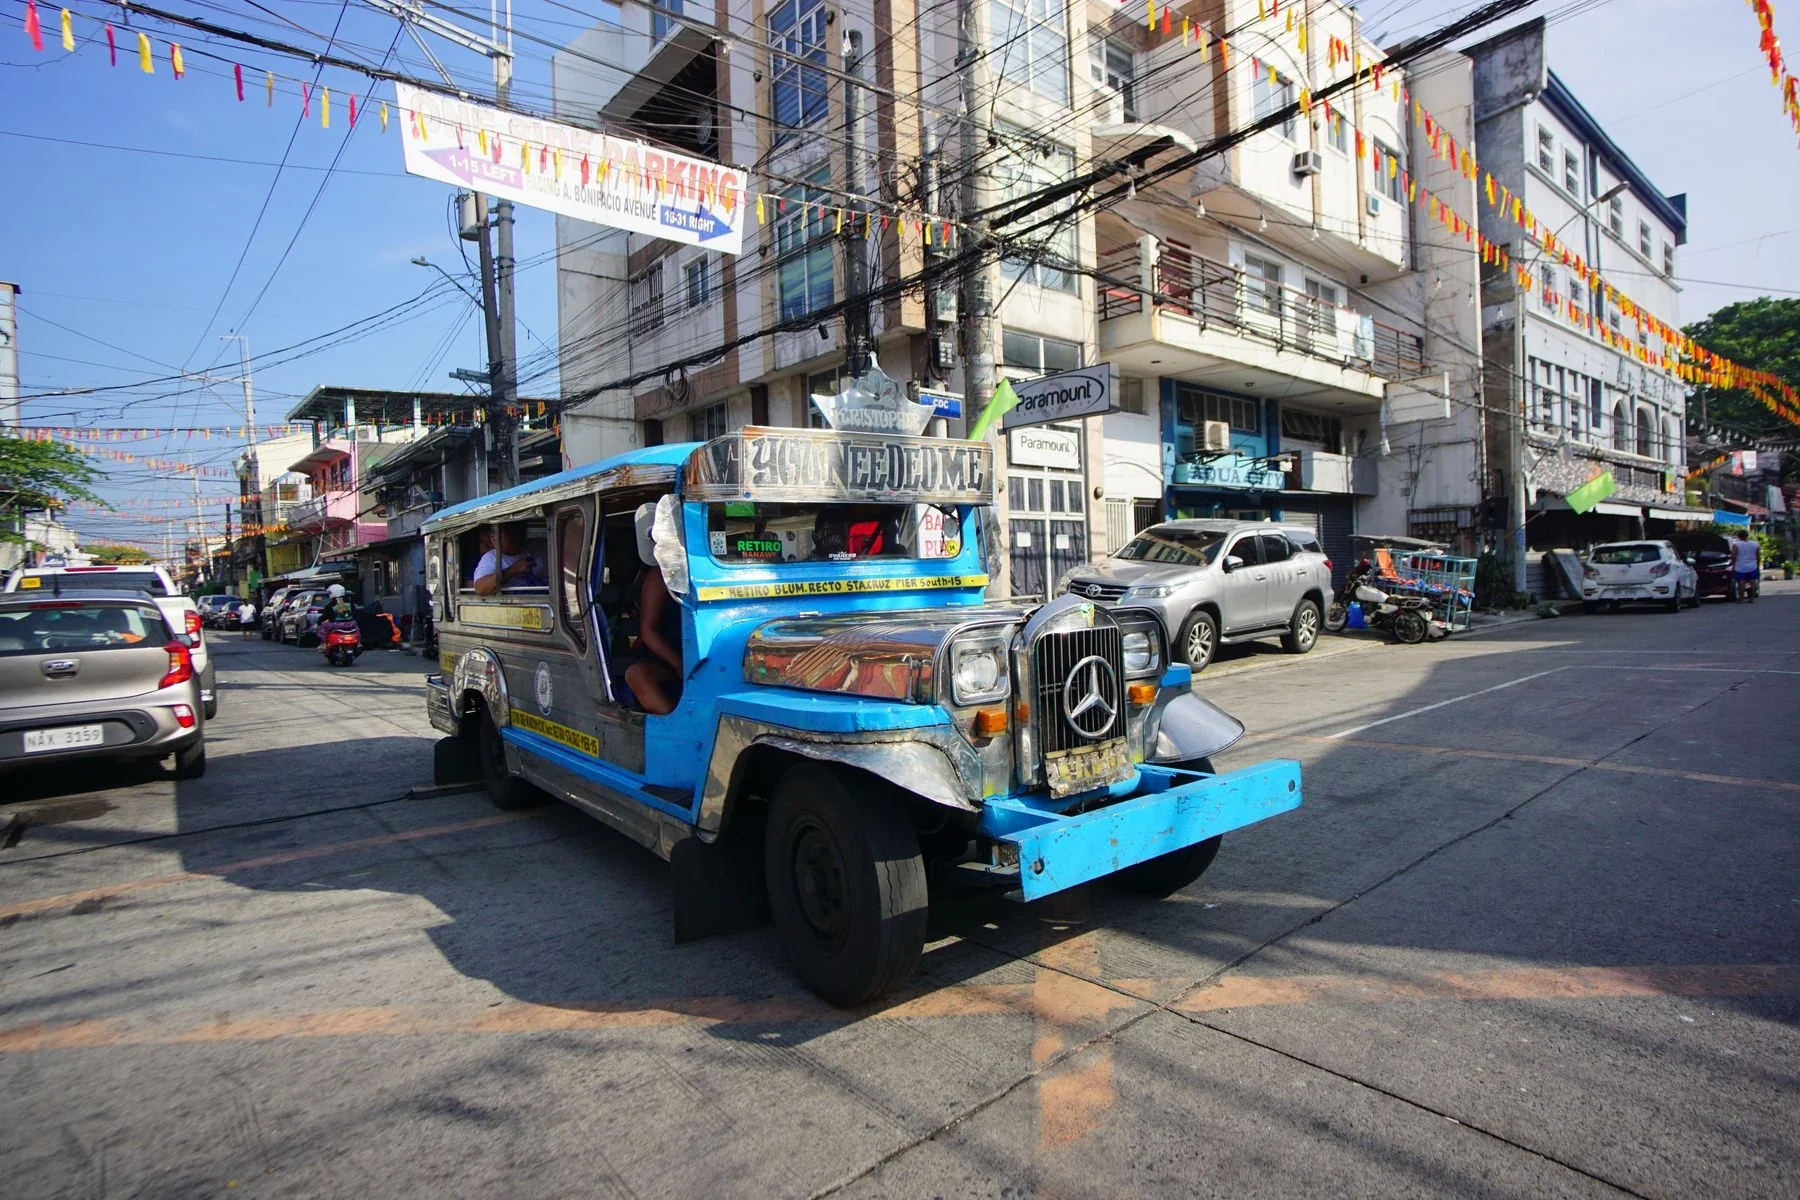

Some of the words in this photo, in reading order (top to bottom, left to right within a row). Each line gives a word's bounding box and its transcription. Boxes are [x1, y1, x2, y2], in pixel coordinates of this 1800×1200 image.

[449, 154, 479, 173] 1-15
[483, 163, 518, 185] LEFT
[602, 141, 738, 209] PARKING
[574, 186, 621, 211] BONIFACIO
[623, 198, 656, 221] AVENUE
[689, 217, 715, 234] RIGHT
[1016, 380, 1091, 413] Paramount
[1020, 435, 1070, 453] Paramount
[737, 540, 781, 552] RETIRO
[896, 578, 917, 589] PIER
